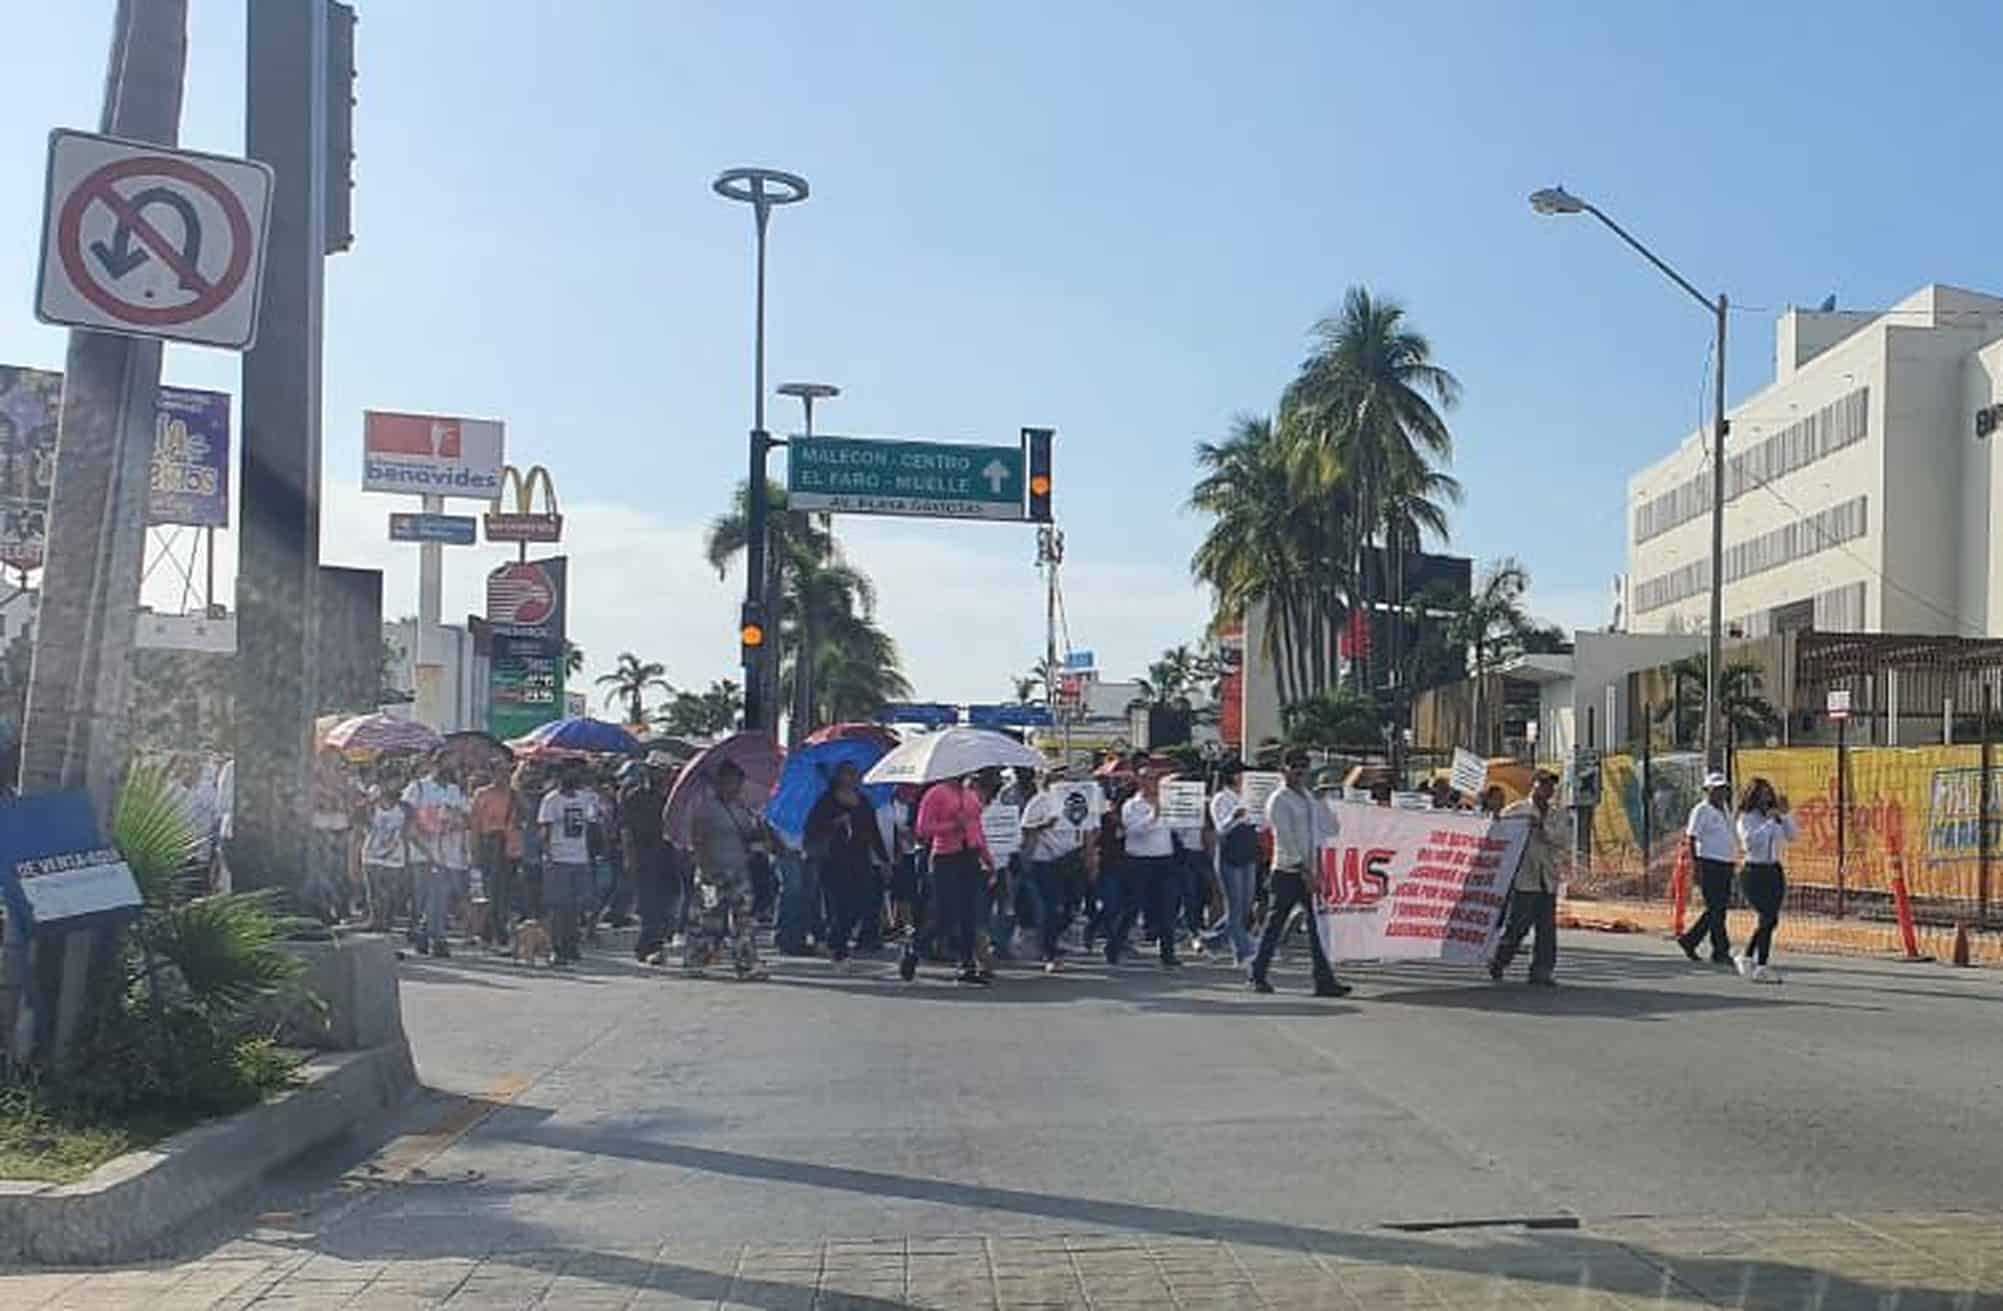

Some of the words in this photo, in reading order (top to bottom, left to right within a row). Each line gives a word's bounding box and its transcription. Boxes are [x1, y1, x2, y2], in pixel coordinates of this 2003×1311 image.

[802, 447, 887, 467] MALECON
[900, 453, 970, 470] CENTRO
[367, 461, 498, 488] benavides
[801, 469, 823, 486] EL
[829, 470, 880, 488] FARO
[896, 476, 970, 494] MUELLE
